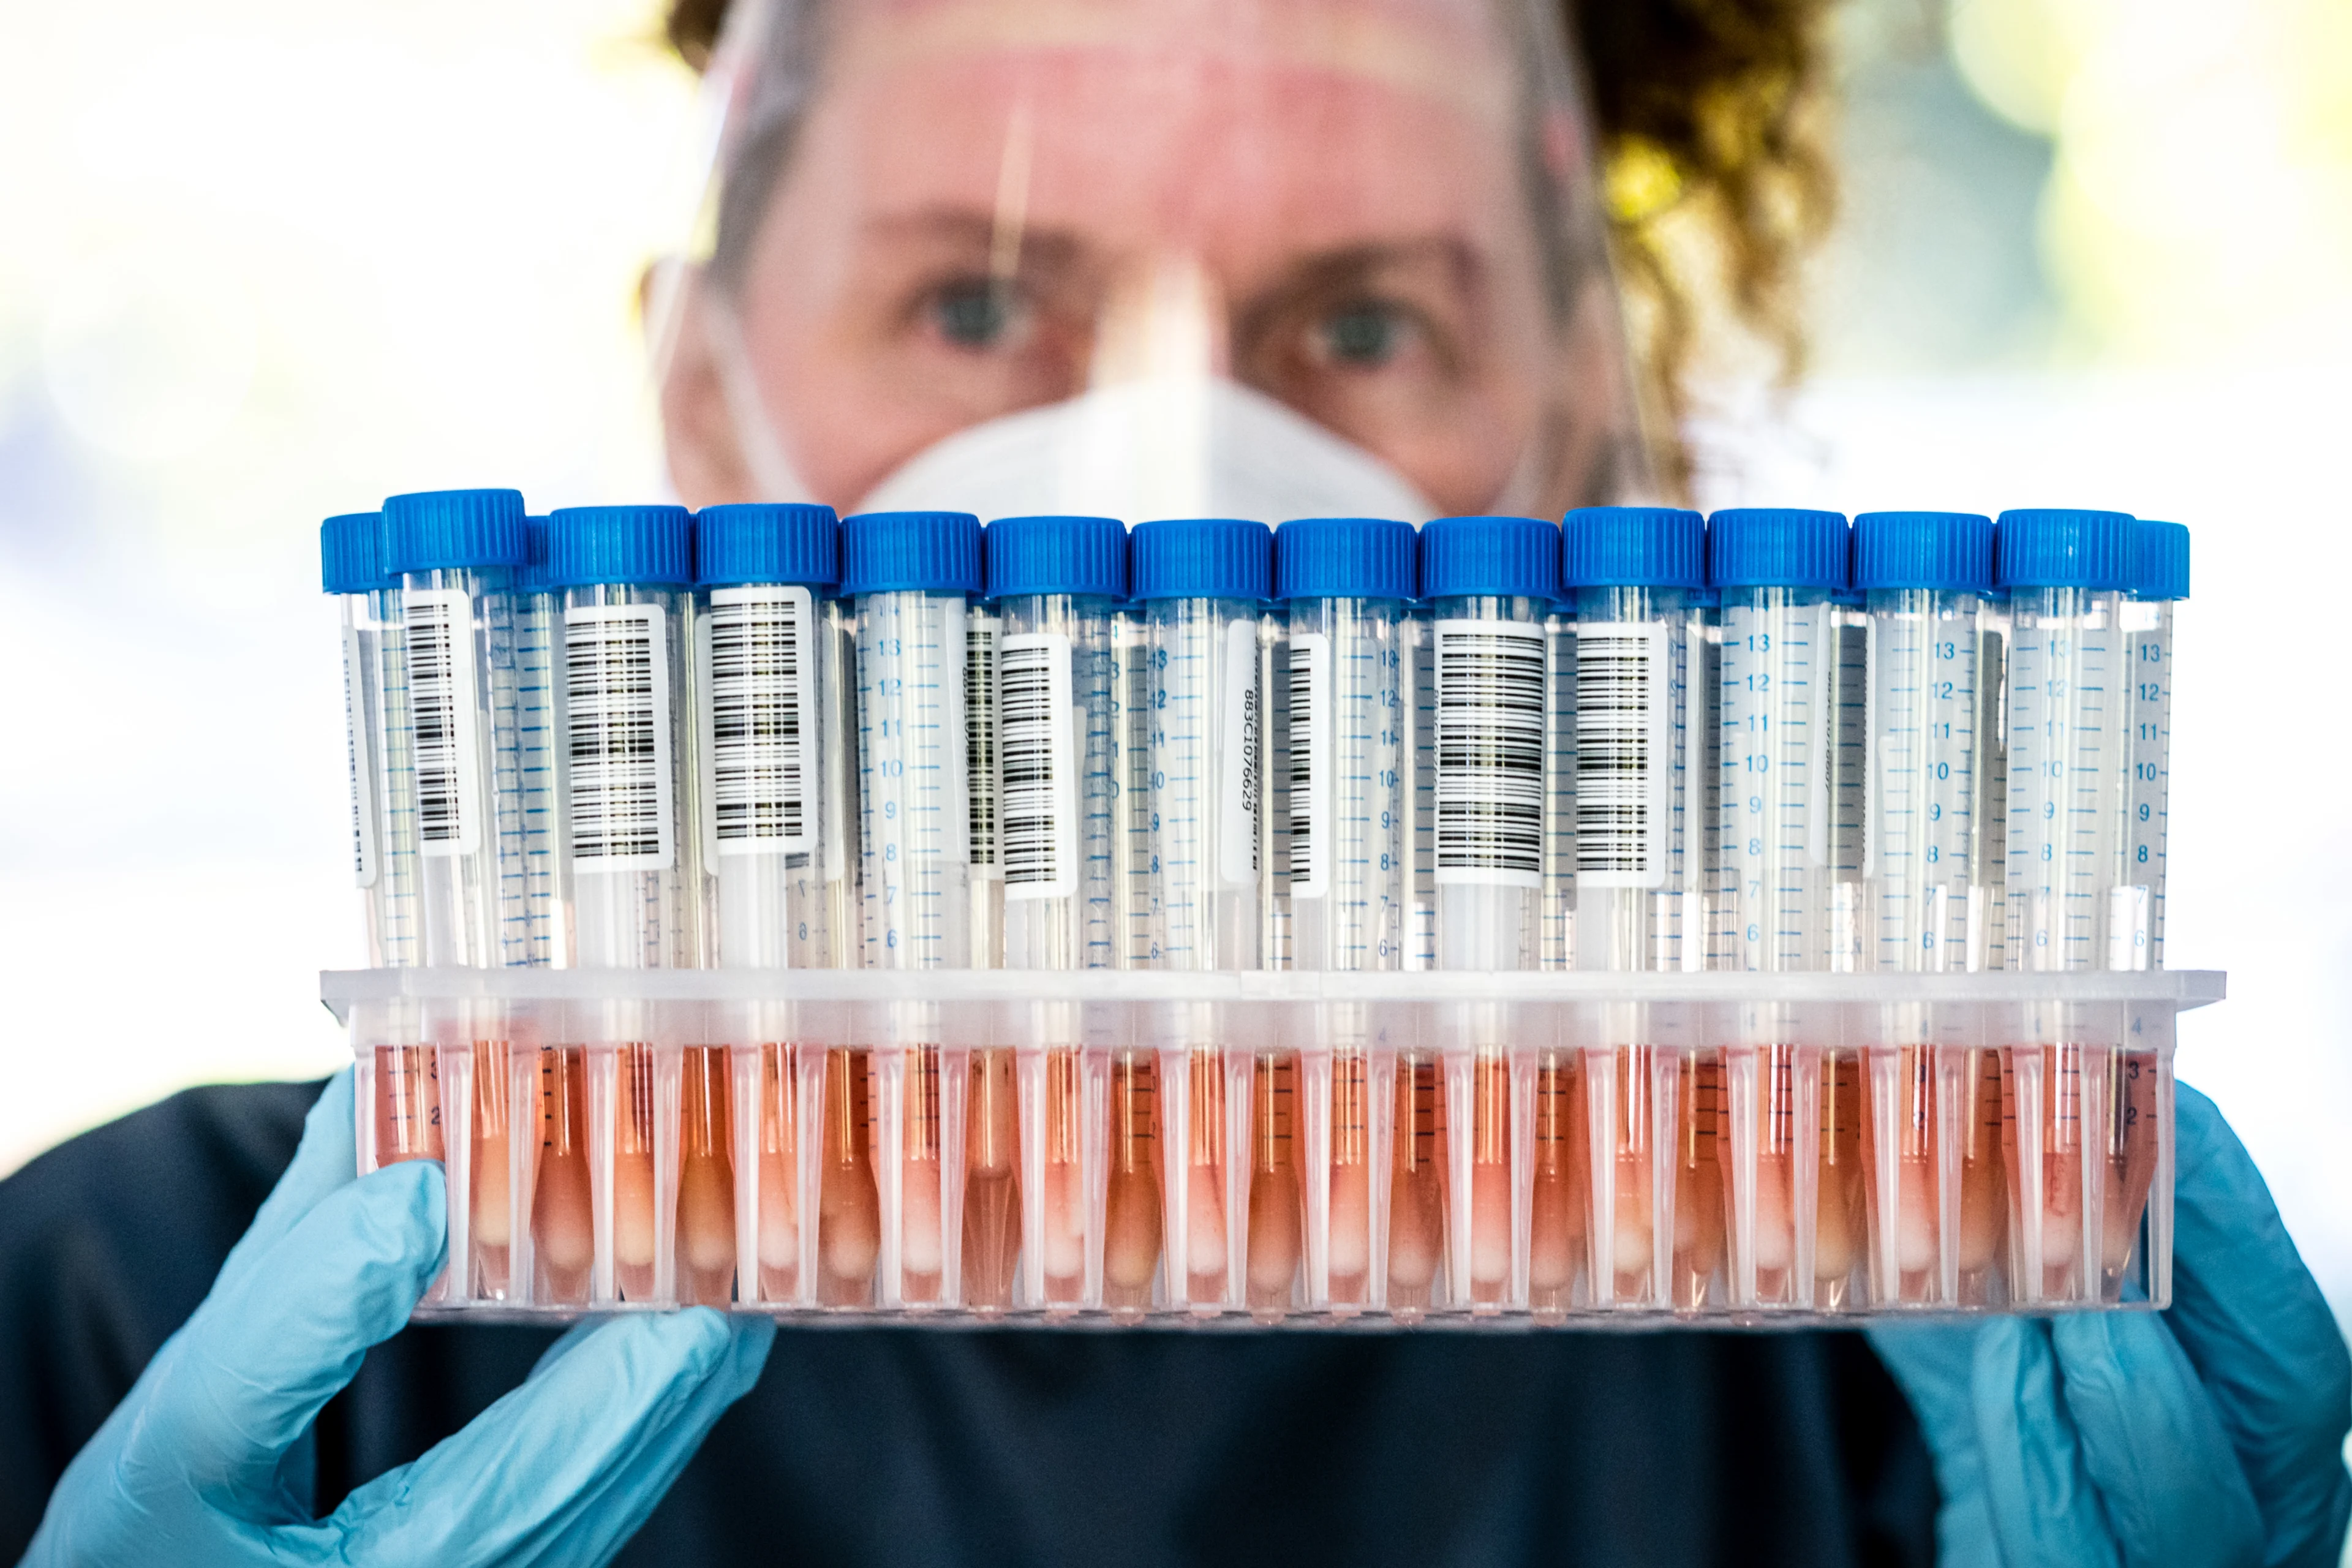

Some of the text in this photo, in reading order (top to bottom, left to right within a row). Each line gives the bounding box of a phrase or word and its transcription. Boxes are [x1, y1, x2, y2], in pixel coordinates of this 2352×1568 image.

[878, 639, 900, 656] 13
[1748, 634, 1770, 652] 13
[1935, 641, 1954, 660] 13
[2049, 640, 2070, 658] 13
[1152, 650, 1167, 669] 13
[1382, 649, 1396, 668] 13
[2141, 644, 2160, 662] 13
[878, 679, 901, 696] 12
[1747, 674, 1770, 692] 12
[1931, 682, 1953, 699] 12
[2046, 679, 2068, 697] 12
[1152, 689, 1166, 709] 12
[1381, 690, 1395, 707] 12
[2139, 684, 2158, 701] 12
[881, 719, 900, 737] 11
[1748, 714, 1768, 731] 11
[1931, 722, 1950, 739] 11
[2046, 720, 2064, 737] 11
[1382, 729, 1394, 747] 11
[2139, 723, 2157, 741] 11
[1242, 689, 1253, 811] 883C1076629
[881, 760, 903, 777] 10
[1746, 755, 1768, 772] 10
[1928, 762, 1948, 780] 10
[2043, 760, 2063, 778] 10
[2137, 763, 2156, 781] 10
[1379, 770, 1395, 788] 10
[885, 801, 895, 819] 9
[1749, 796, 1762, 814] 9
[1929, 803, 1940, 821] 9
[2044, 801, 2054, 819] 9
[2139, 804, 2149, 821] 9
[1152, 813, 1159, 832] 9
[1381, 811, 1390, 829] 9
[886, 843, 896, 861] 8
[1749, 838, 1761, 856] 8
[1927, 845, 1938, 863] 8
[2041, 843, 2052, 861] 8
[2138, 845, 2148, 862] 8
[1152, 855, 1159, 873] 8
[1381, 853, 1389, 870] 8
[886, 886, 897, 903] 7
[1748, 880, 1760, 898] 7
[1926, 888, 1936, 907] 7
[2040, 886, 2050, 903] 7
[2137, 886, 2146, 903] 7
[1380, 895, 1389, 912] 7
[886, 930, 897, 948] 6
[1747, 924, 1758, 941] 6
[1923, 931, 1934, 949] 6
[2036, 929, 2048, 946] 6
[2134, 930, 2145, 947] 6
[1152, 942, 1158, 960] 6
[1379, 939, 1387, 957] 6
[2128, 1061, 2139, 1079] 3
[431, 1106, 440, 1125] 2
[2127, 1107, 2137, 1125] 2
